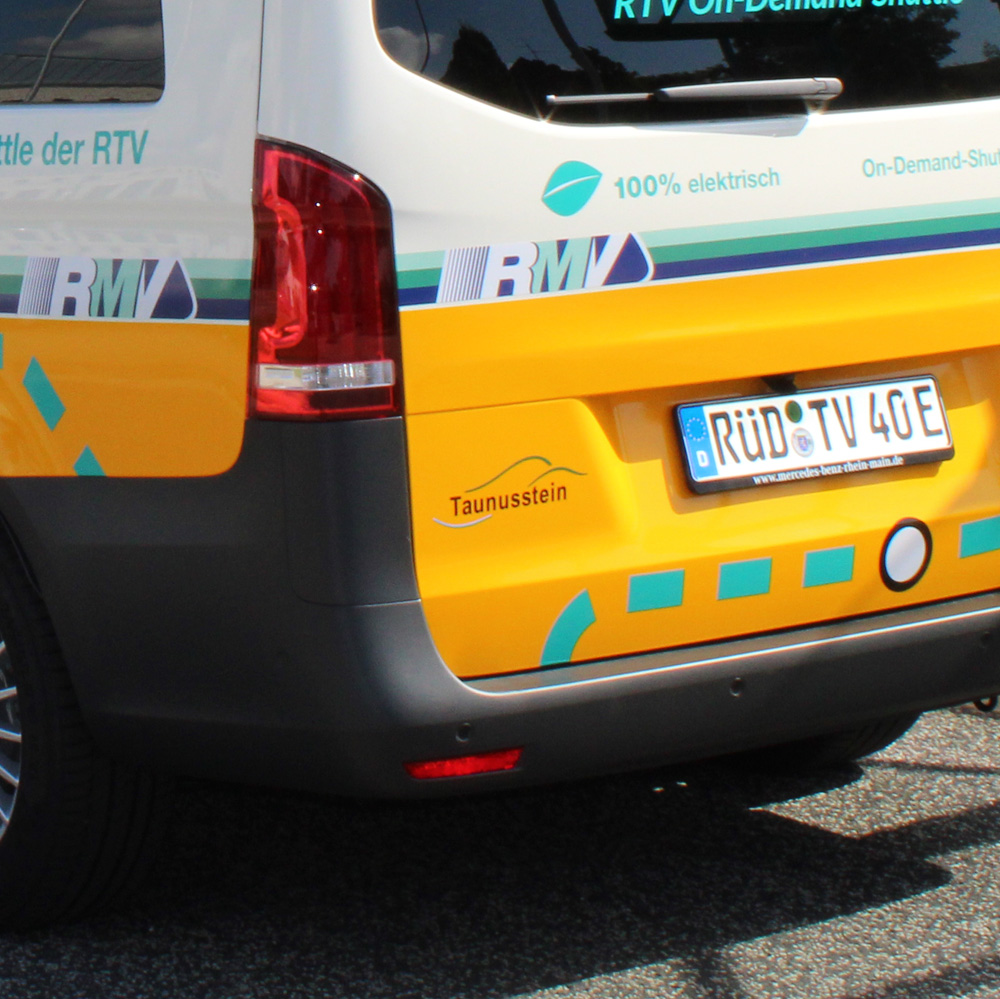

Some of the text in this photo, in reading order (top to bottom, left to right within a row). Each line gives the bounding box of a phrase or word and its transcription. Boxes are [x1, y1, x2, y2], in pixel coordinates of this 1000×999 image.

[41, 131, 86, 166] der
[91, 129, 150, 165] RTV
[614, 166, 781, 200] 100% elektrisch
[482, 232, 642, 300] RMV
[53, 256, 188, 319] RMV
[807, 395, 858, 451] TV
[697, 450, 710, 468] D
[752, 454, 904, 485] www.mercedes-benz-rhein-main.de
[450, 482, 567, 516] Taunusstein
